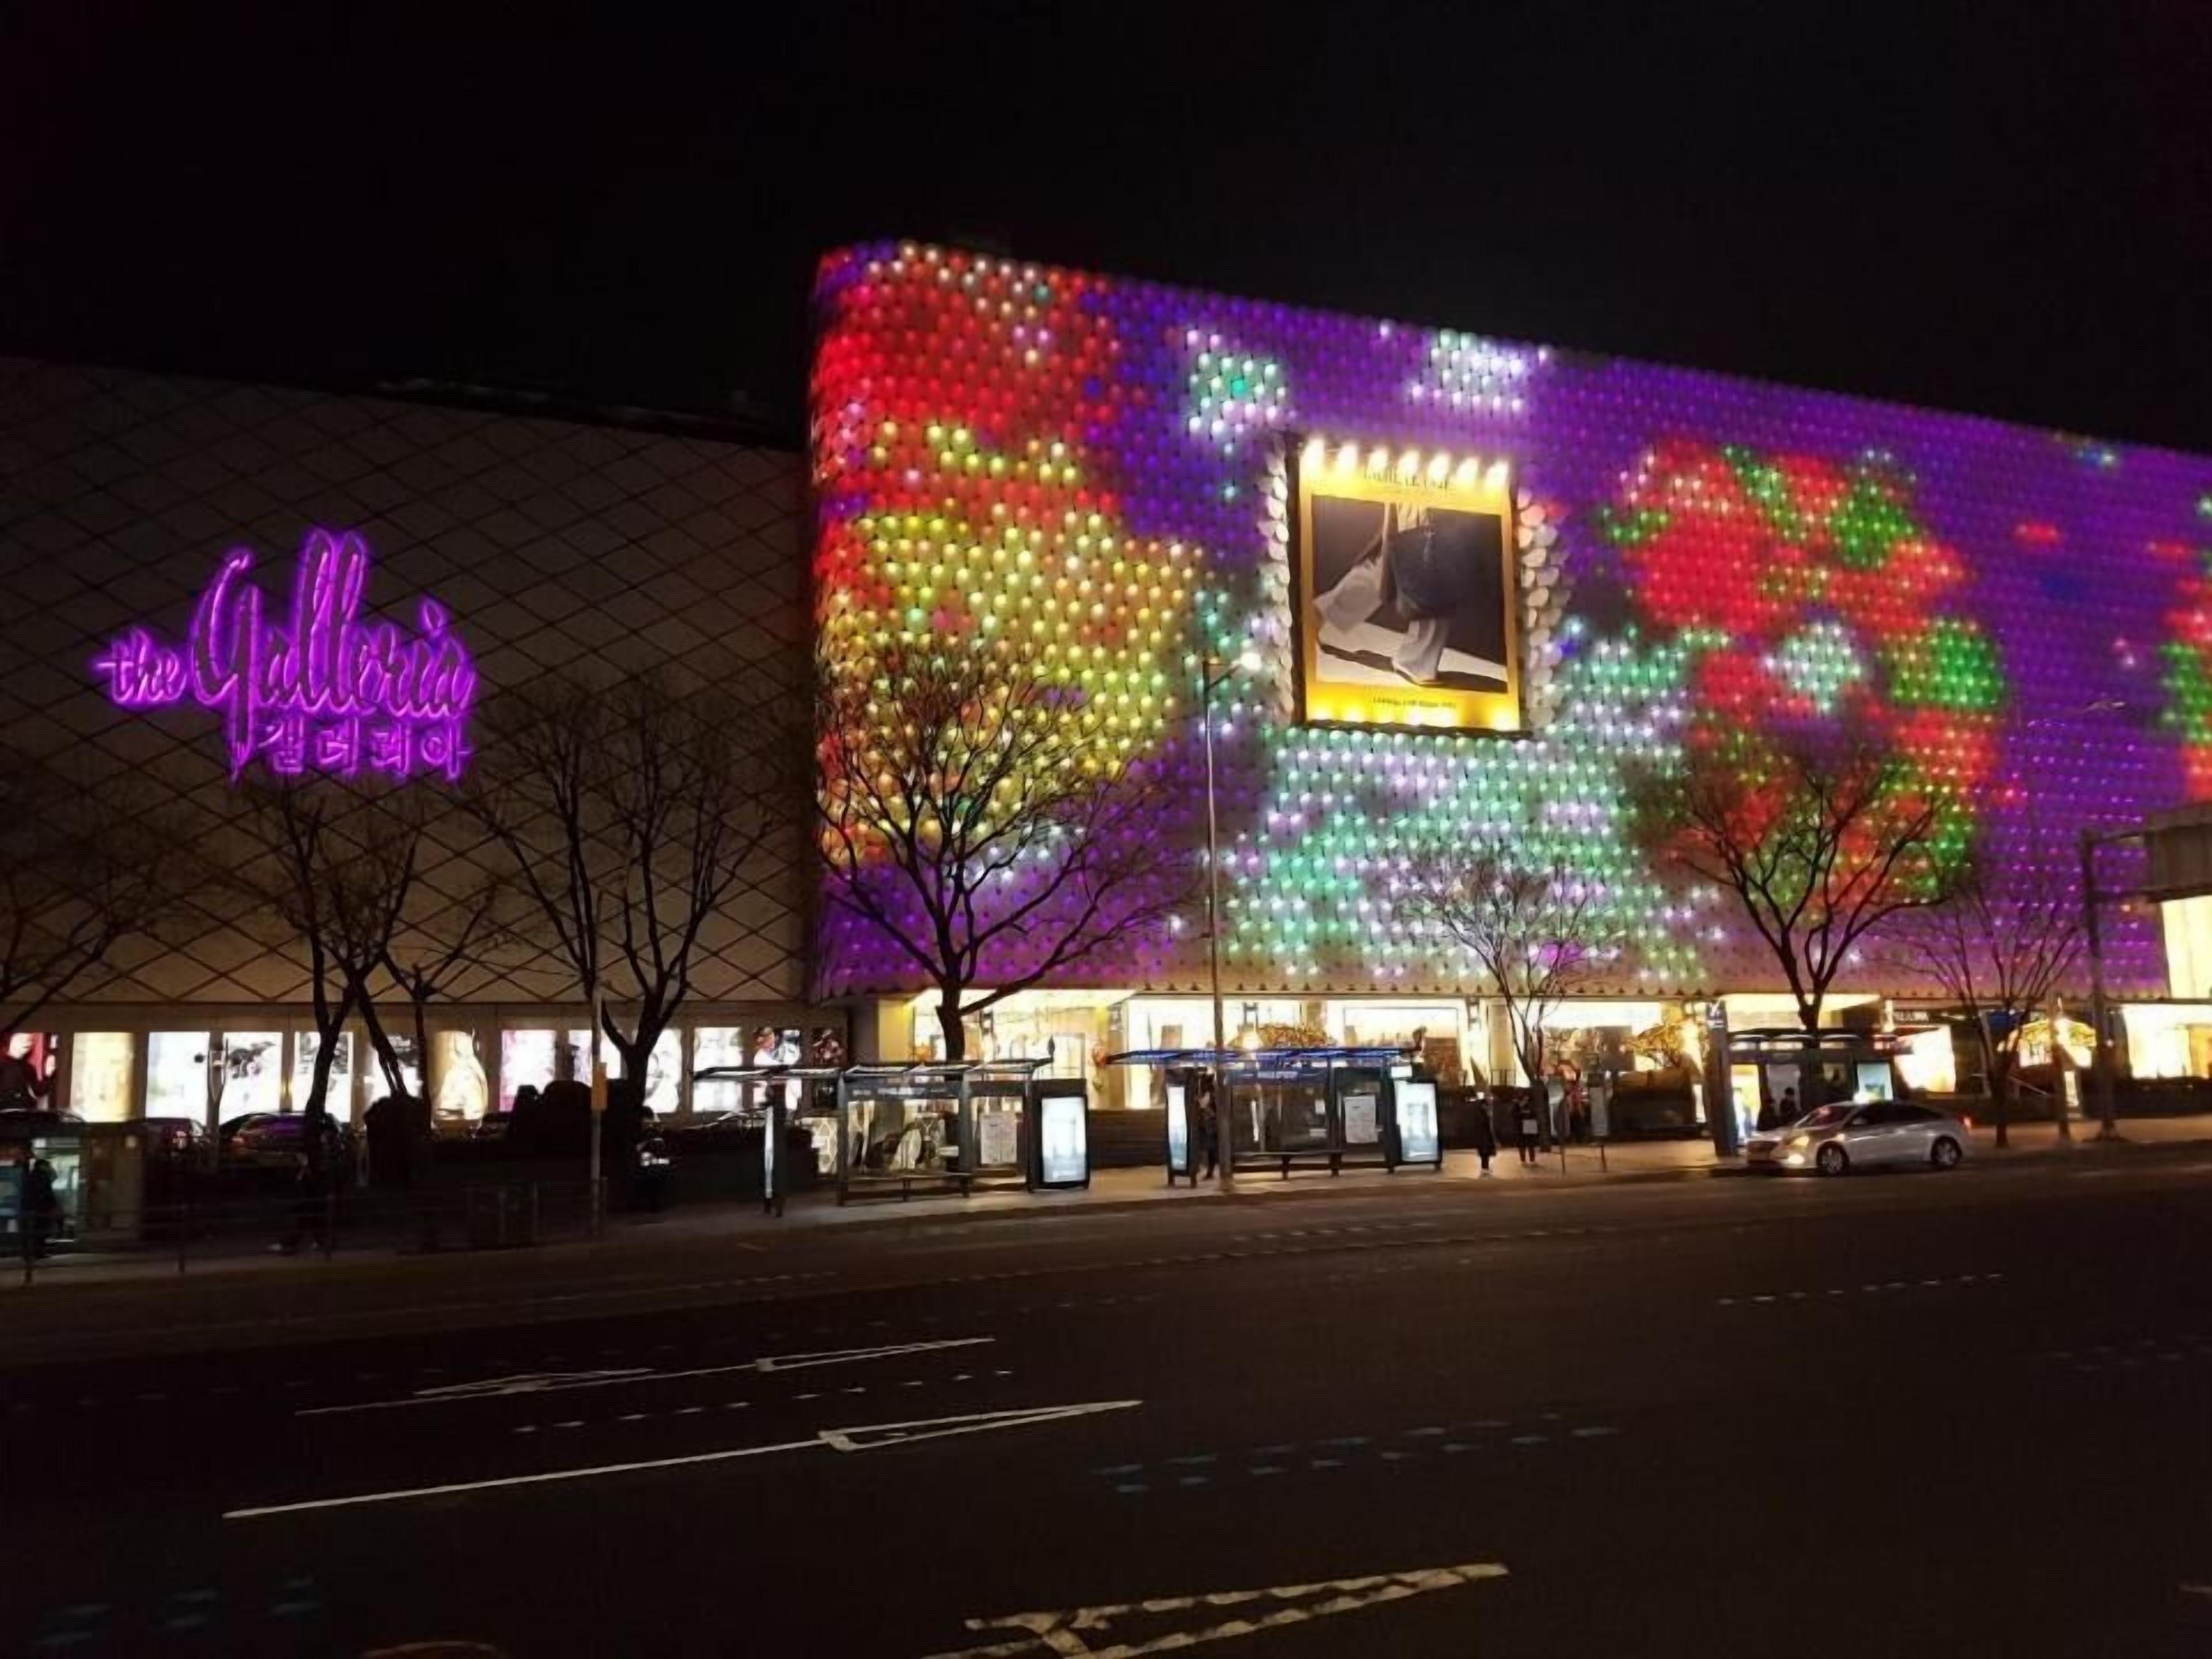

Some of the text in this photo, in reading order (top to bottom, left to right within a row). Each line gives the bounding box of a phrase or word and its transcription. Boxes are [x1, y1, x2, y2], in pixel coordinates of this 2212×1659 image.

[94, 528, 478, 780] the Galleria
[257, 718, 472, 780] 갤러리아
